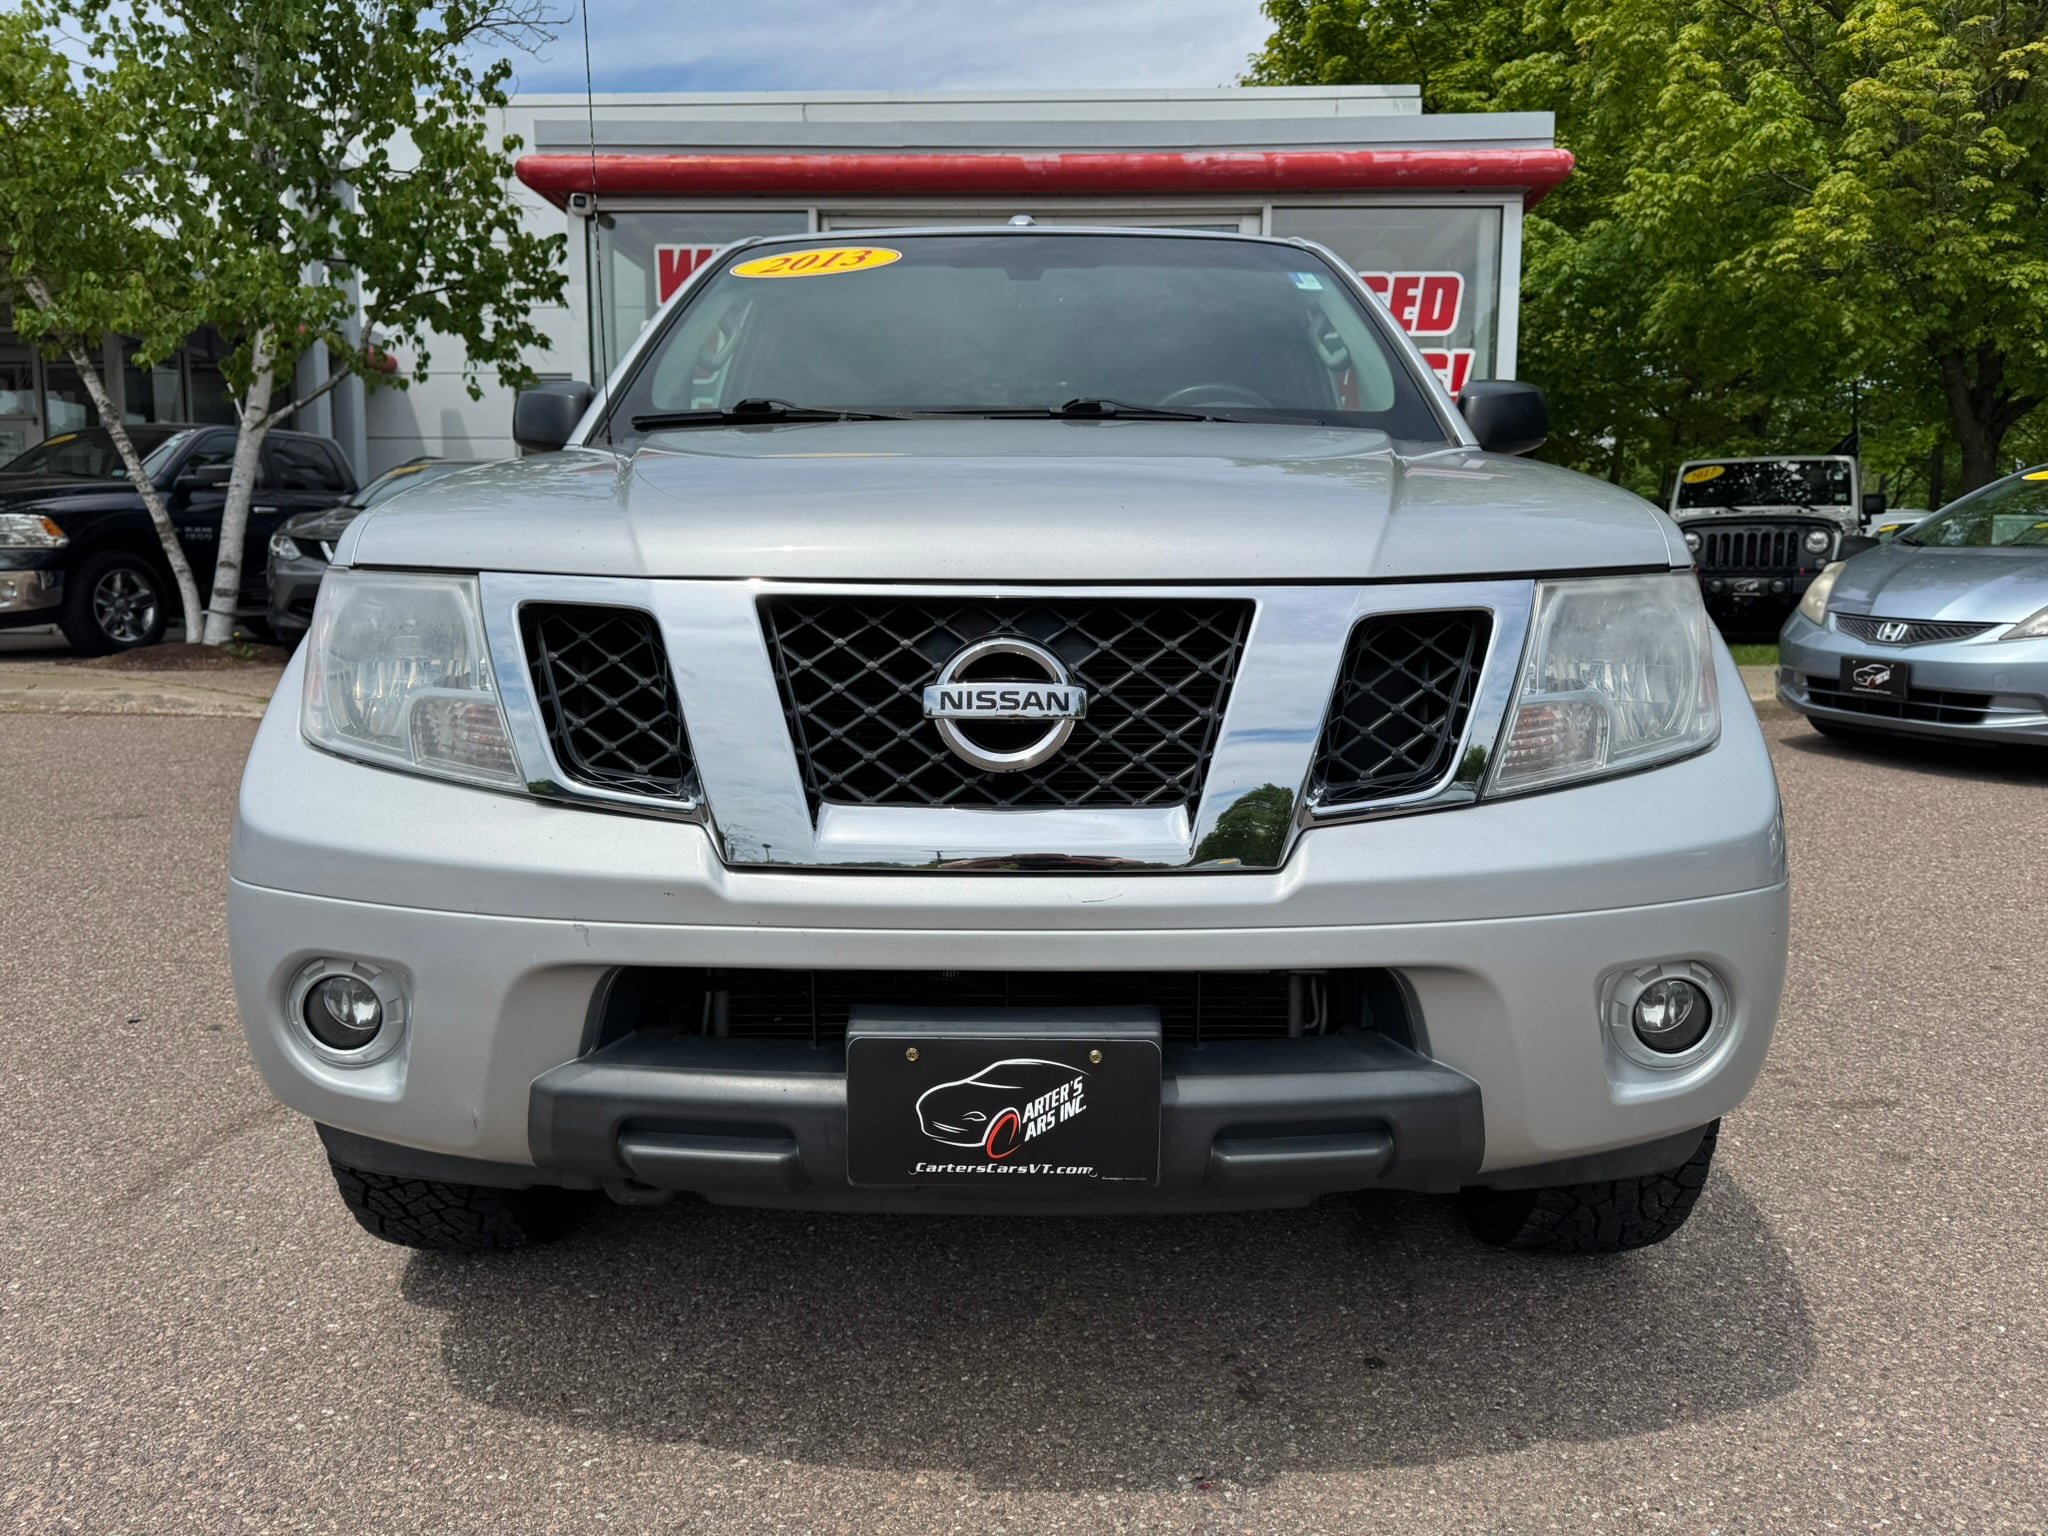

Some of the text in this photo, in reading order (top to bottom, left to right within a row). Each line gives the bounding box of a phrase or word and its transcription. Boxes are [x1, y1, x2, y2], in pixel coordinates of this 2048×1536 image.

[758, 250, 872, 274] 2013
[940, 691, 1069, 711] NISSAN
[1060, 1093, 1087, 1123] INC.
[915, 1163, 1093, 1175] CartersCarsVT.com
